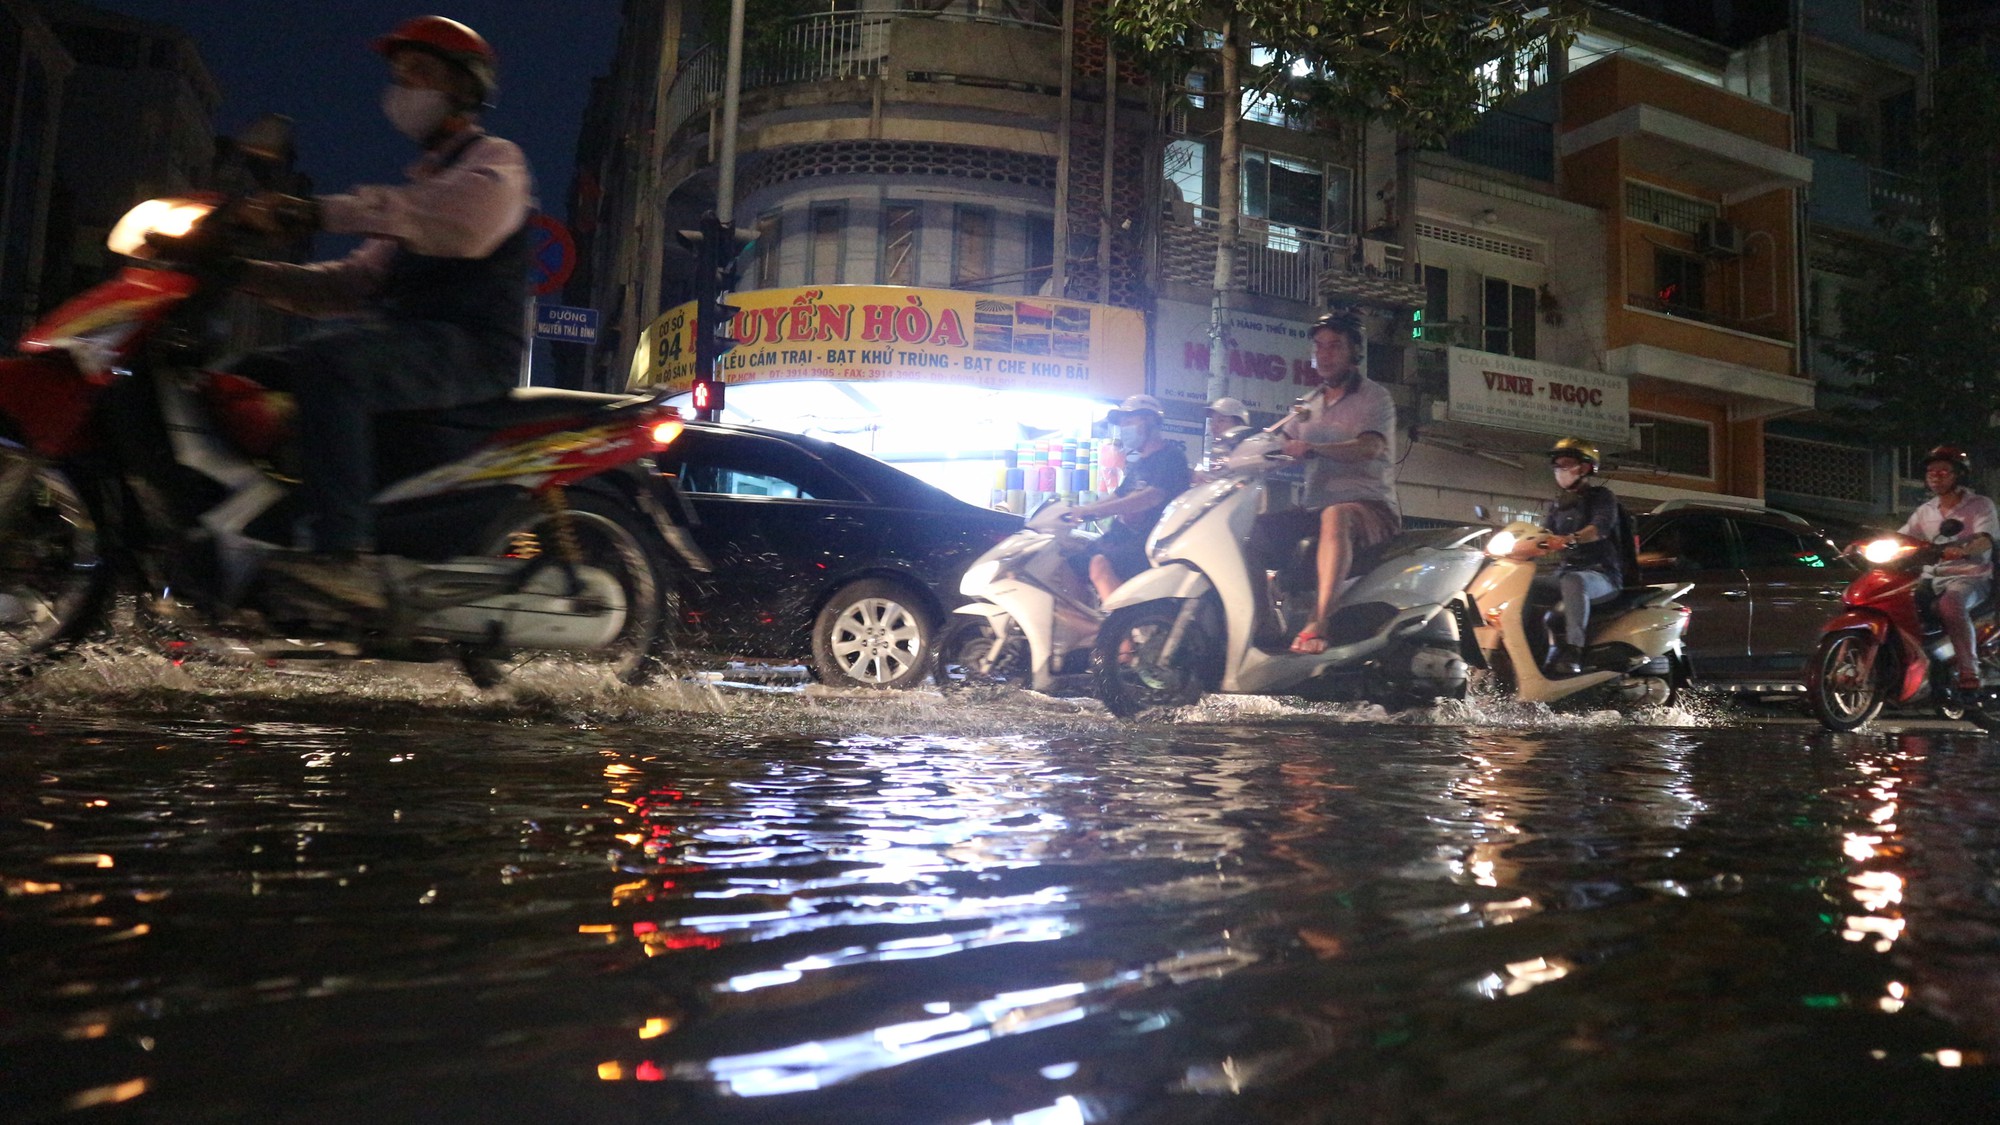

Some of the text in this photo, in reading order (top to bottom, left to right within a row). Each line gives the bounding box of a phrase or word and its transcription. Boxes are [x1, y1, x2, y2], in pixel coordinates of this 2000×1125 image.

[548, 309, 587, 323] ĐƯỜNG
[688, 290, 969, 352] UYỄN HÒA
[658, 332, 682, 367] 94
[781, 350, 812, 367] TRẠI
[826, 350, 856, 366] BẠT
[861, 345, 894, 365] KHỬ
[899, 349, 950, 369] TRÙNG
[963, 355, 992, 374] BẠT
[997, 359, 1027, 375] CHE
[1032, 361, 1062, 378] KHO
[1482, 371, 1534, 396] VINH
[1549, 381, 1603, 408] NGỌC
